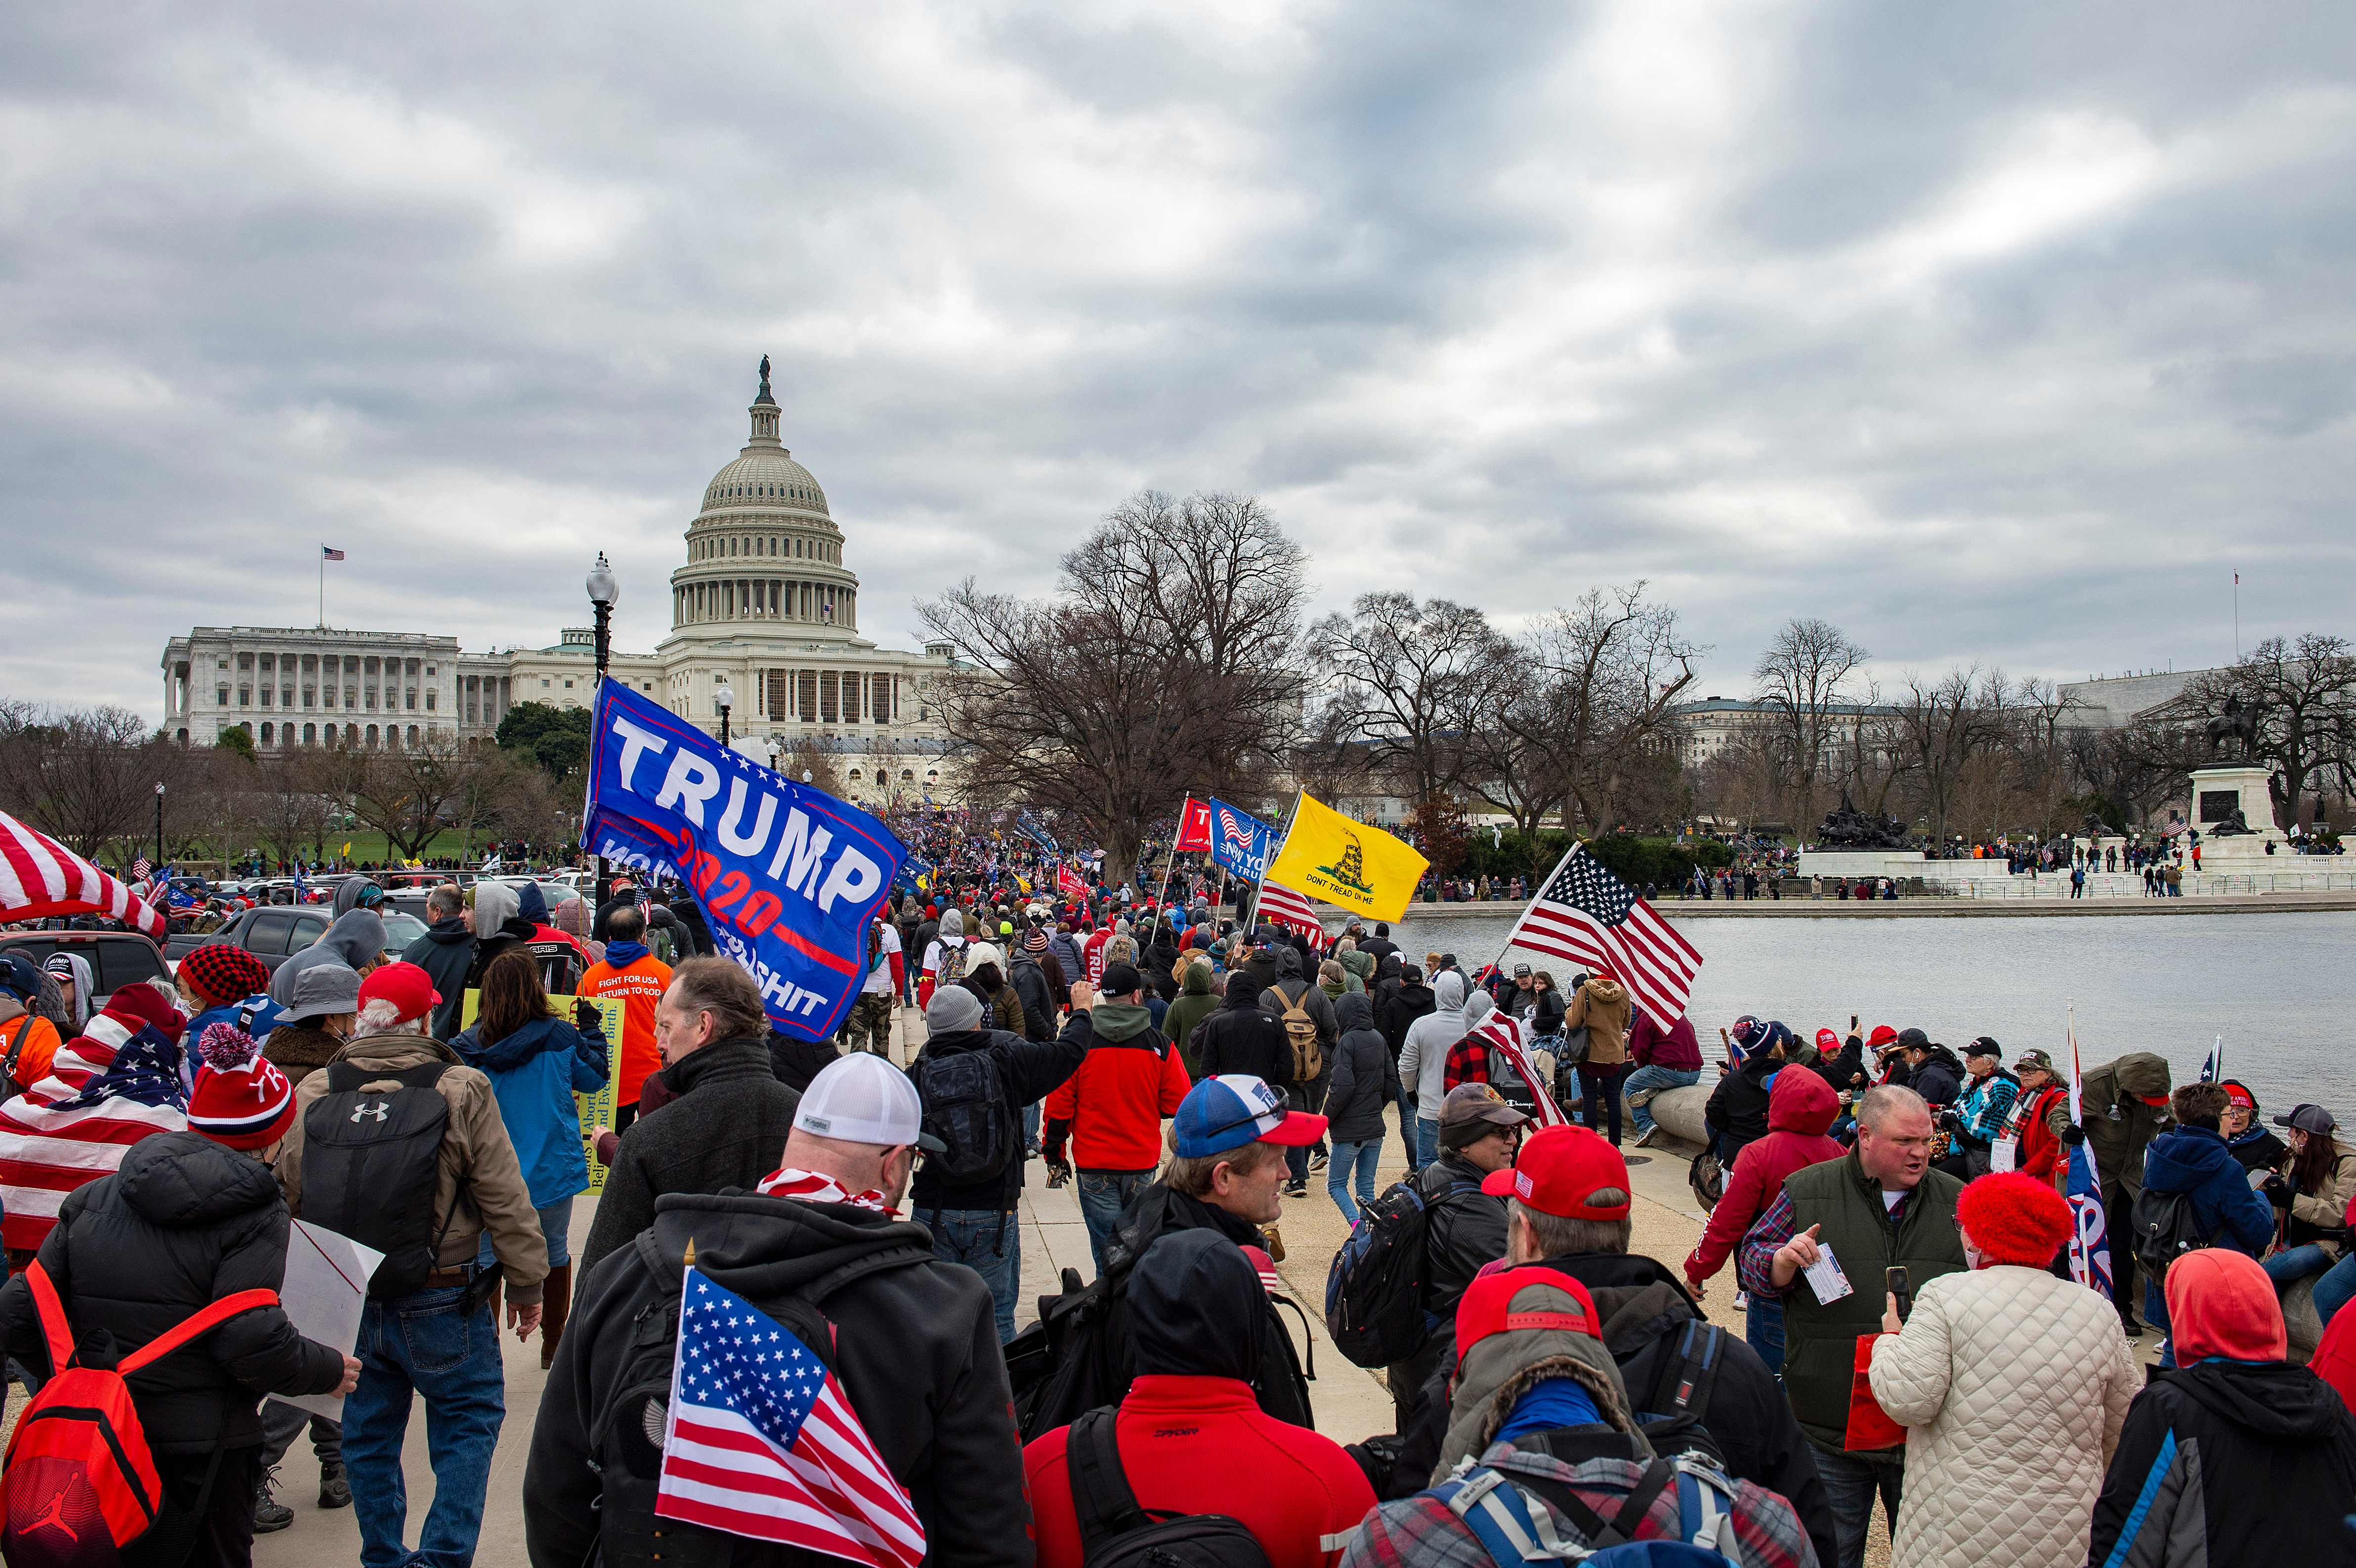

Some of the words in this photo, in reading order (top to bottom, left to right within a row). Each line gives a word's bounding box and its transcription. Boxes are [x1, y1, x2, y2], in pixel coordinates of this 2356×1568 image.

[612, 715, 881, 915] TRUMP
[676, 828, 783, 938] 2020
[1062, 868, 1090, 888] TRUMP
[1238, 866, 1260, 879] TRU
[1306, 873, 1328, 887] DONT
[1329, 883, 1353, 897] TREAD
[1354, 893, 1362, 901] ON
[1363, 896, 1374, 905] ME
[599, 976, 622, 988] FIGHT
[624, 975, 640, 984] FOR
[642, 976, 658, 984] USA
[1090, 946, 1101, 995] TRUM
[597, 988, 629, 999] RETURN
[644, 987, 661, 996] GOD
[605, 1005, 617, 1039] Birth.
[583, 1091, 597, 1131] Abort
[1505, 1099, 1535, 1109] Champi
[592, 1164, 604, 1188] Beli
